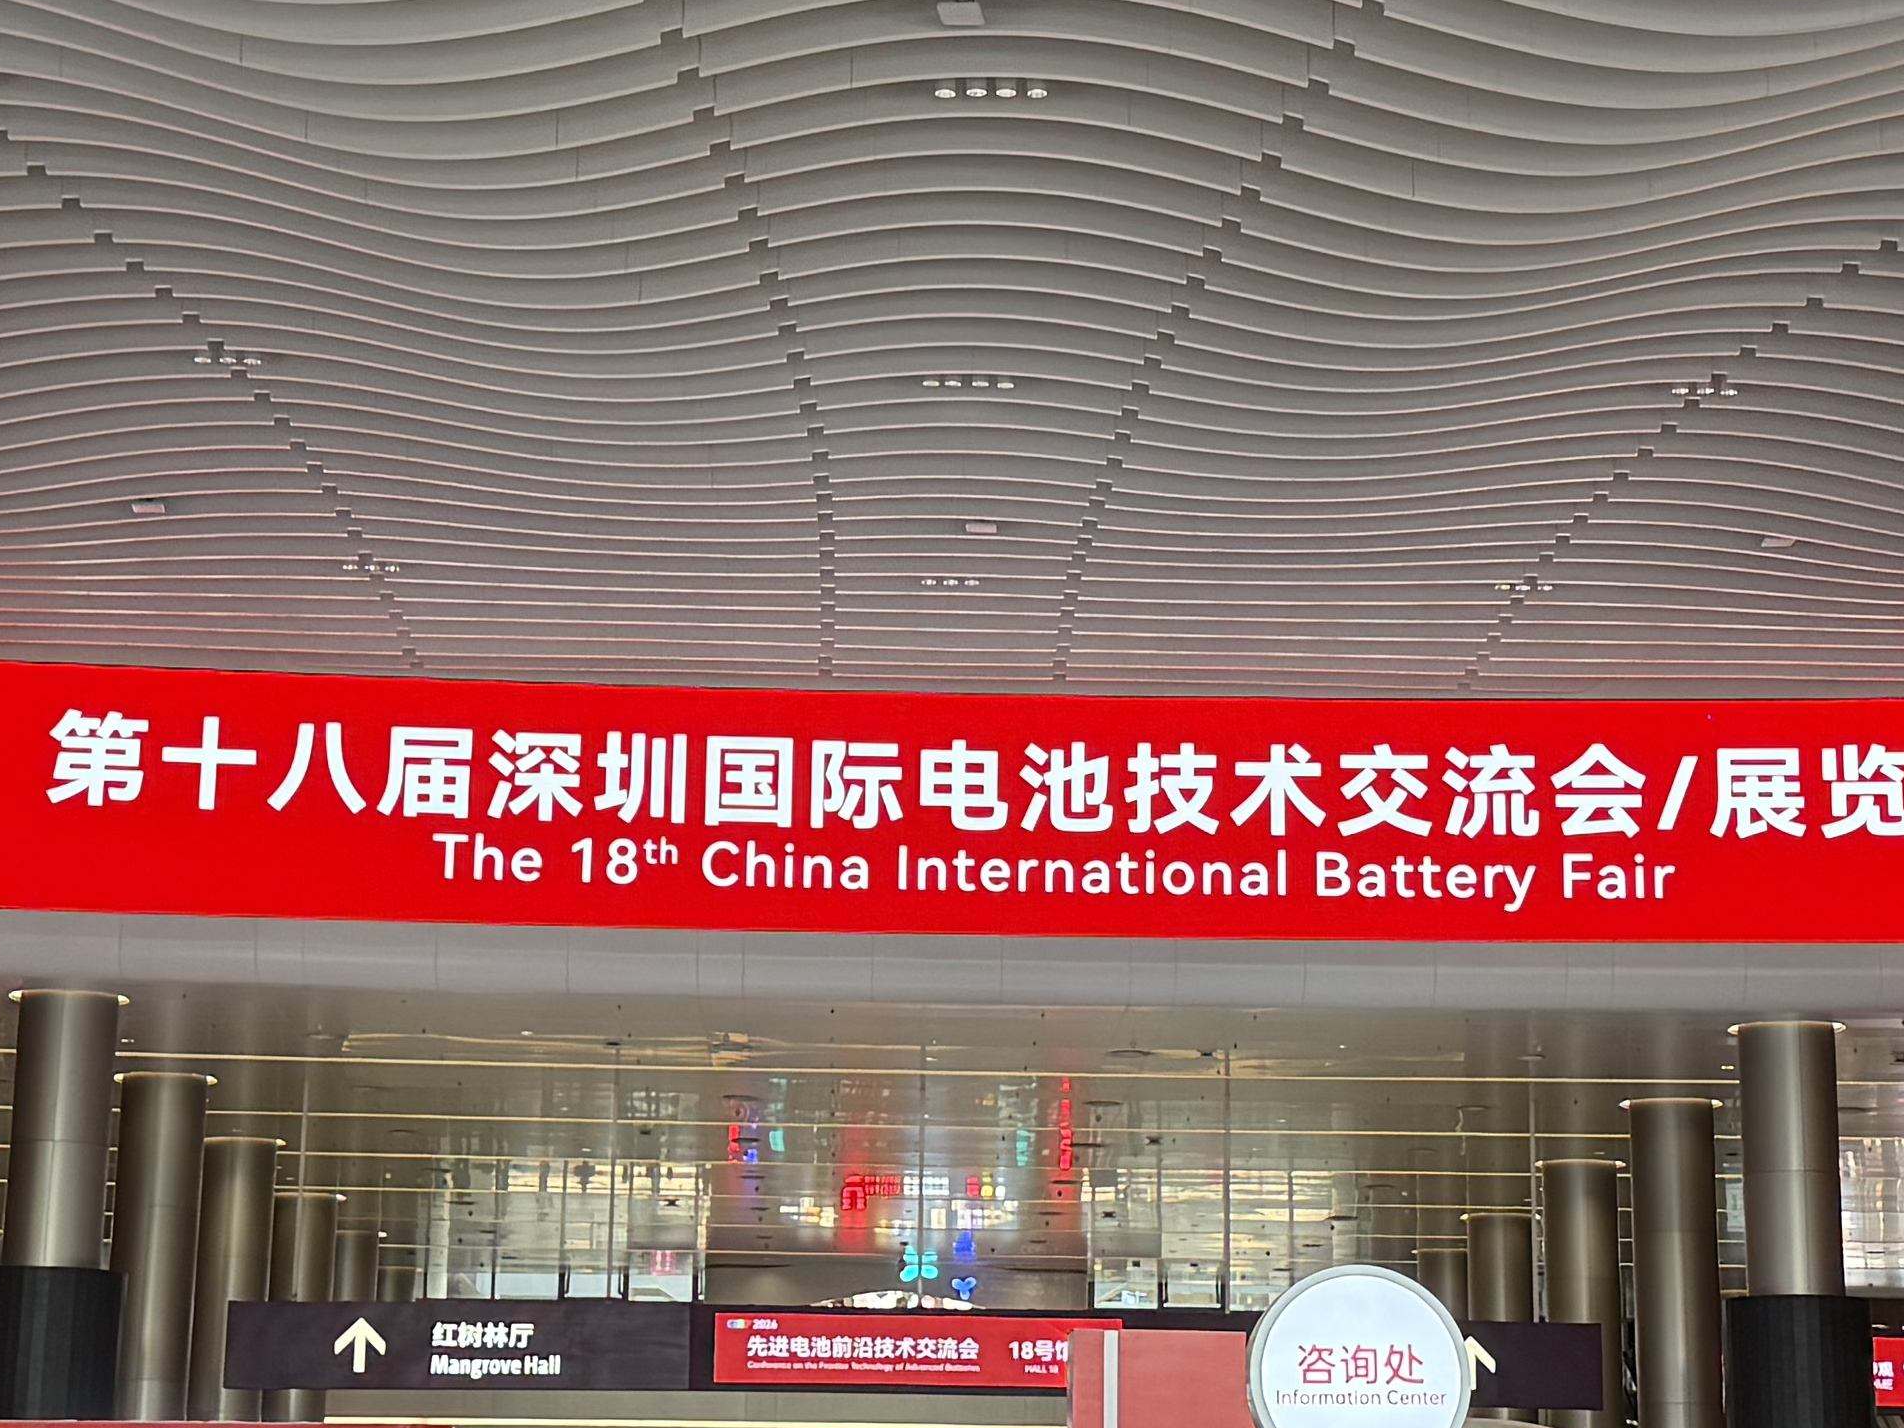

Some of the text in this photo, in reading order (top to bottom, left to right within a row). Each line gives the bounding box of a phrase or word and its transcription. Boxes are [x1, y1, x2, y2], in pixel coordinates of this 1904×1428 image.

[432, 834, 1675, 911] The 18th China International Battery Fair
[432, 1322, 534, 1350] 红树林厅
[747, 1335, 980, 1360] 先进电池前沿技术交流会
[430, 1354, 561, 1380] Mangrove Hall
[1298, 1344, 1424, 1386] 咨询处
[1276, 1389, 1447, 1406] Information Center
